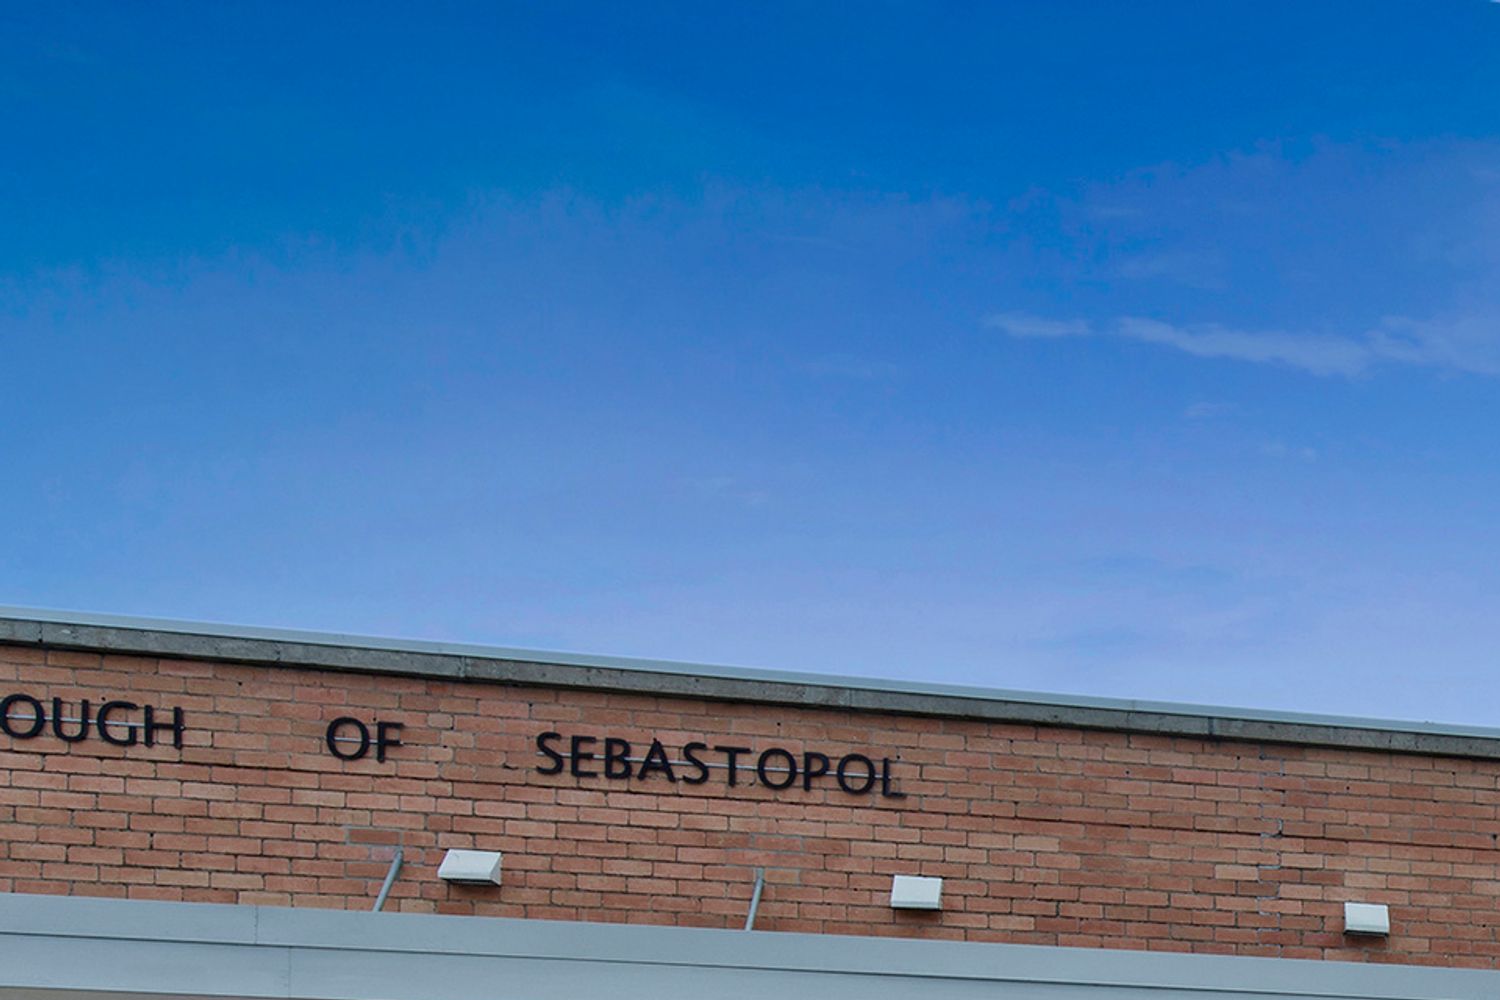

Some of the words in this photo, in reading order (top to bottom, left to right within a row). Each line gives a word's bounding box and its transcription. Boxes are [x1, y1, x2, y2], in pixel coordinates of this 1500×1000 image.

[0, 693, 186, 750] OUGH
[325, 717, 404, 764] OF
[536, 731, 906, 799] SEBASTOPOL
